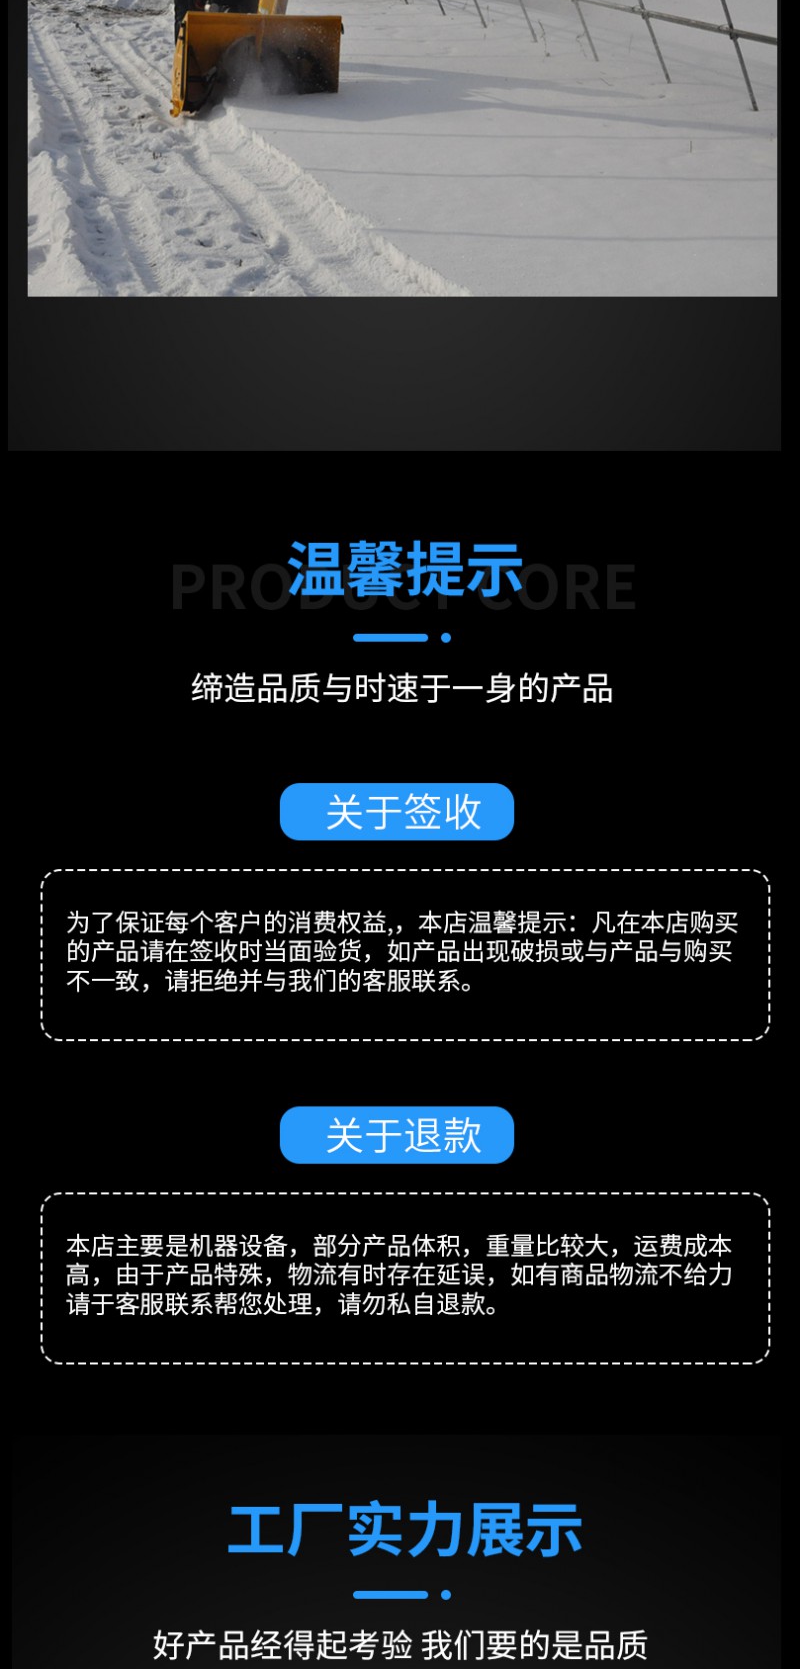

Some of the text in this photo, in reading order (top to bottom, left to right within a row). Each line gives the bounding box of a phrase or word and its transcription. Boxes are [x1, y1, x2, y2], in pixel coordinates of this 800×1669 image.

[287, 540, 523, 598] 温馨提示
[192, 672, 612, 703] 缔造品质与时速于一身的产品
[327, 793, 481, 830] 关于签收
[67, 969, 470, 992] 不一致，请拒绝并与我们的客服联系。
[327, 1117, 481, 1153] 关于退款
[66, 1292, 495, 1316] 请于客服联系帮您处理，请勿私自退款。
[228, 1500, 582, 1557] 工厂实力展示
[154, 1629, 647, 1660] 好产品经得起考验 我们要的是品质
